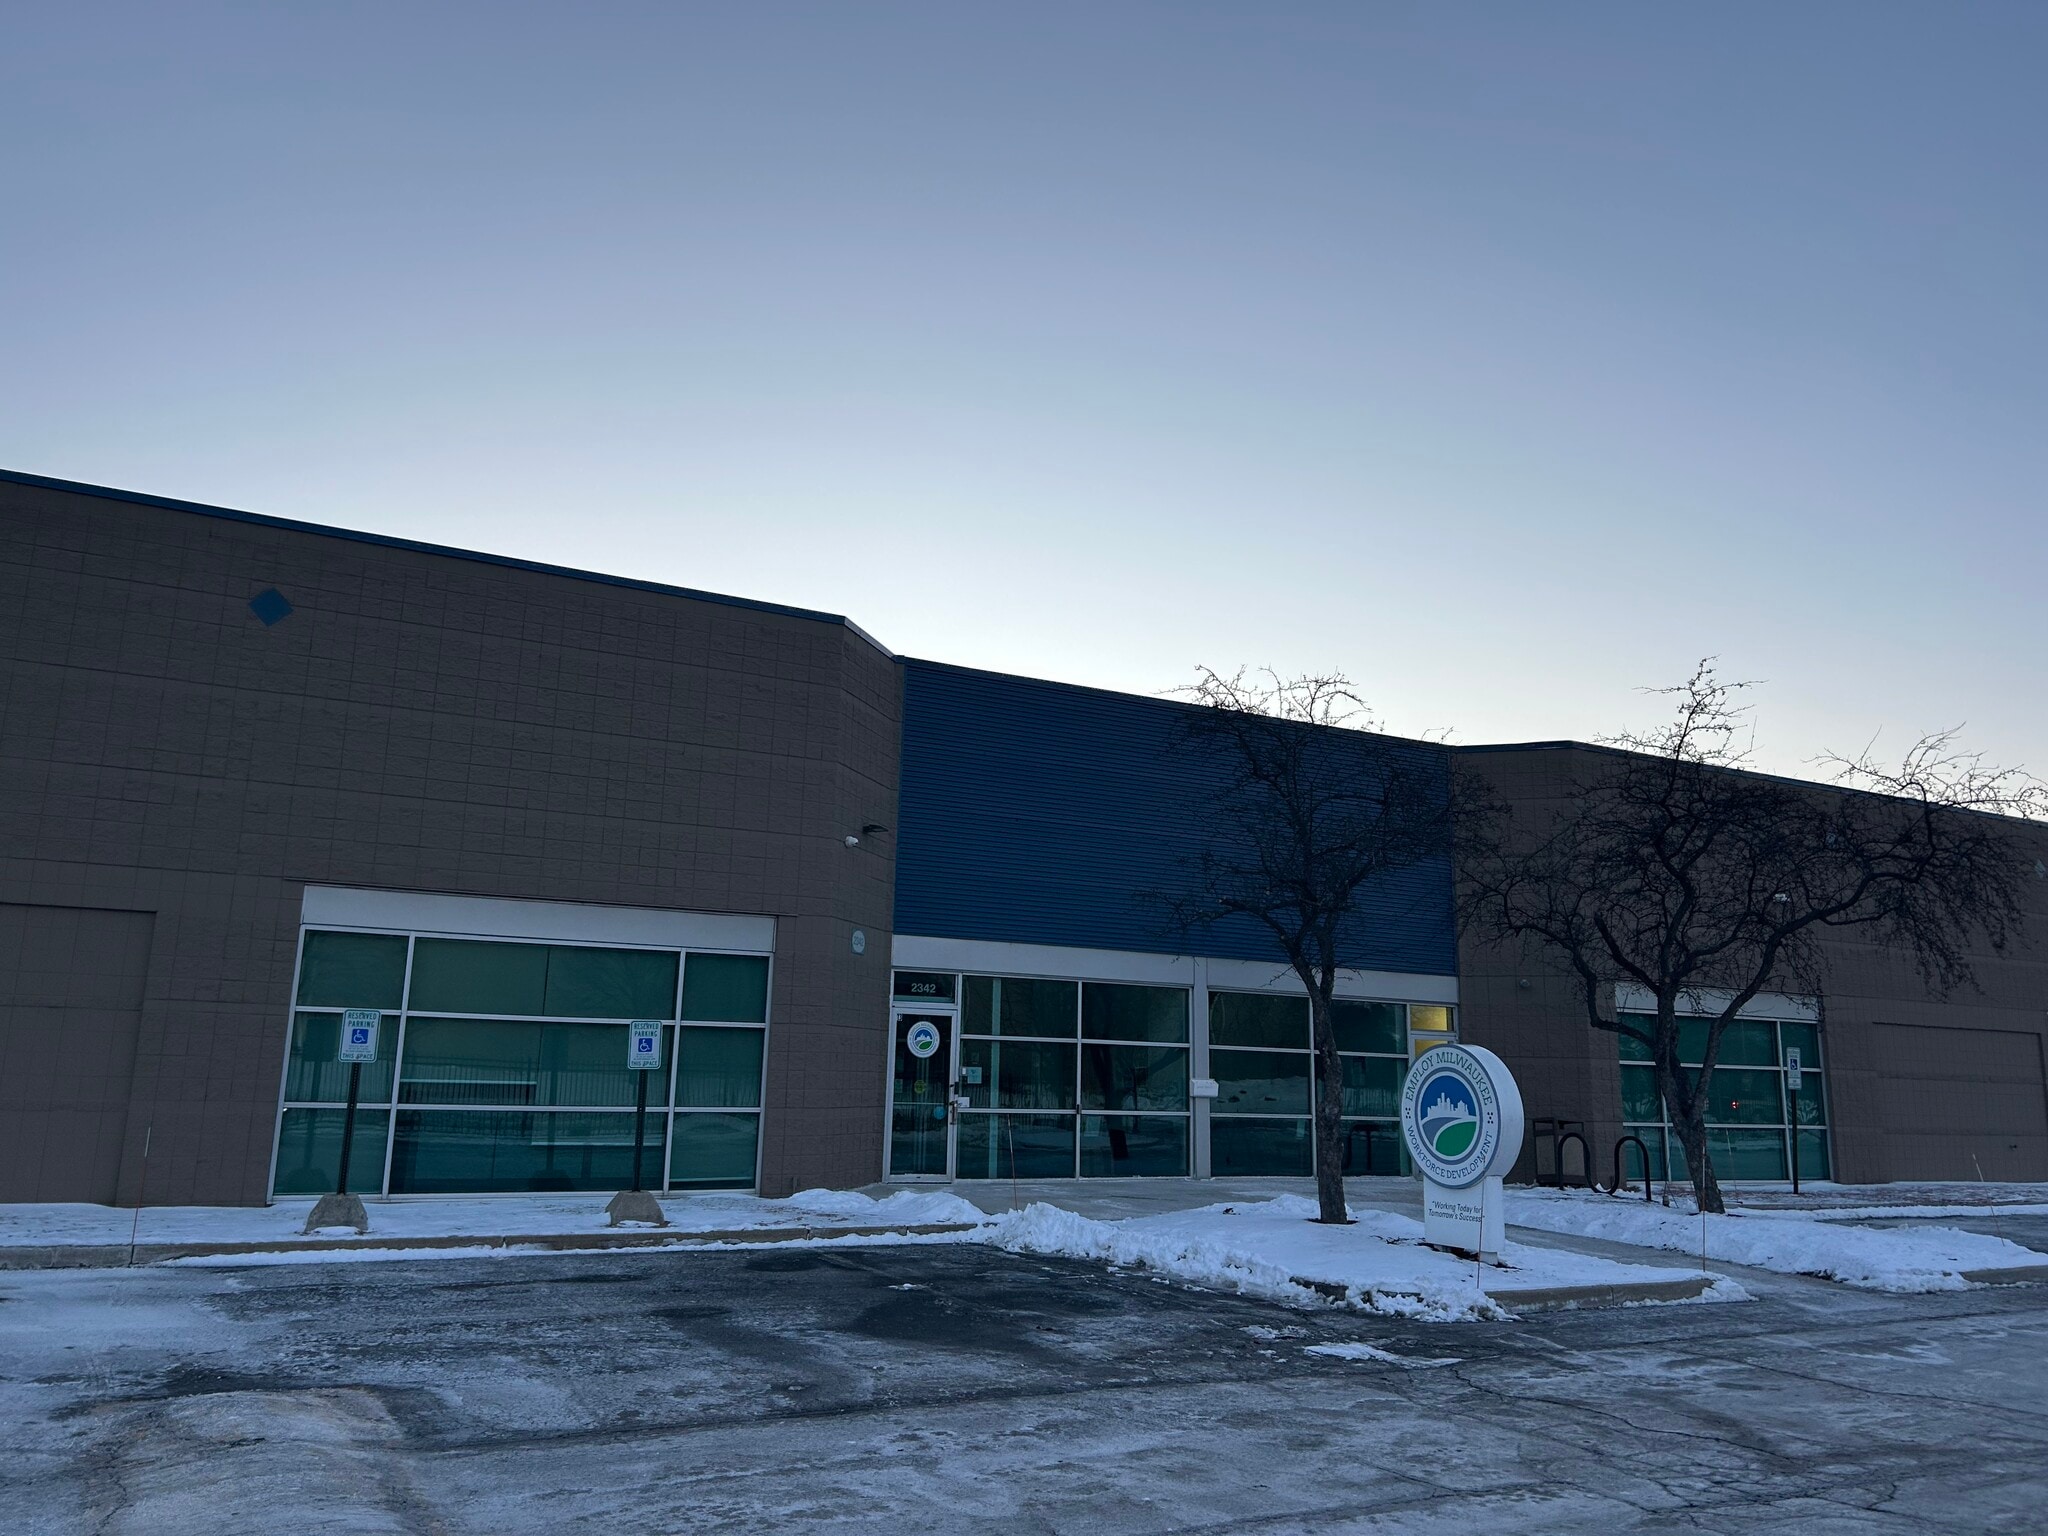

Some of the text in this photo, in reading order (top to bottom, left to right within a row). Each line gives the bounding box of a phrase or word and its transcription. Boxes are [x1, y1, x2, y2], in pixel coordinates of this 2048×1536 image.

[911, 982, 936, 993] 2342
[348, 1012, 377, 1020] RESERVED
[348, 1020, 375, 1028] PARKING
[633, 1022, 659, 1030] RESERVED
[1406, 1051, 1493, 1106] EMPLOY MILWAUKEE
[1407, 1125, 1493, 1179] WORKFORCE DEVELOPMENT
[1432, 1200, 1482, 1214] "Working Today for
[1428, 1208, 1458, 1219] Tomorrow's
